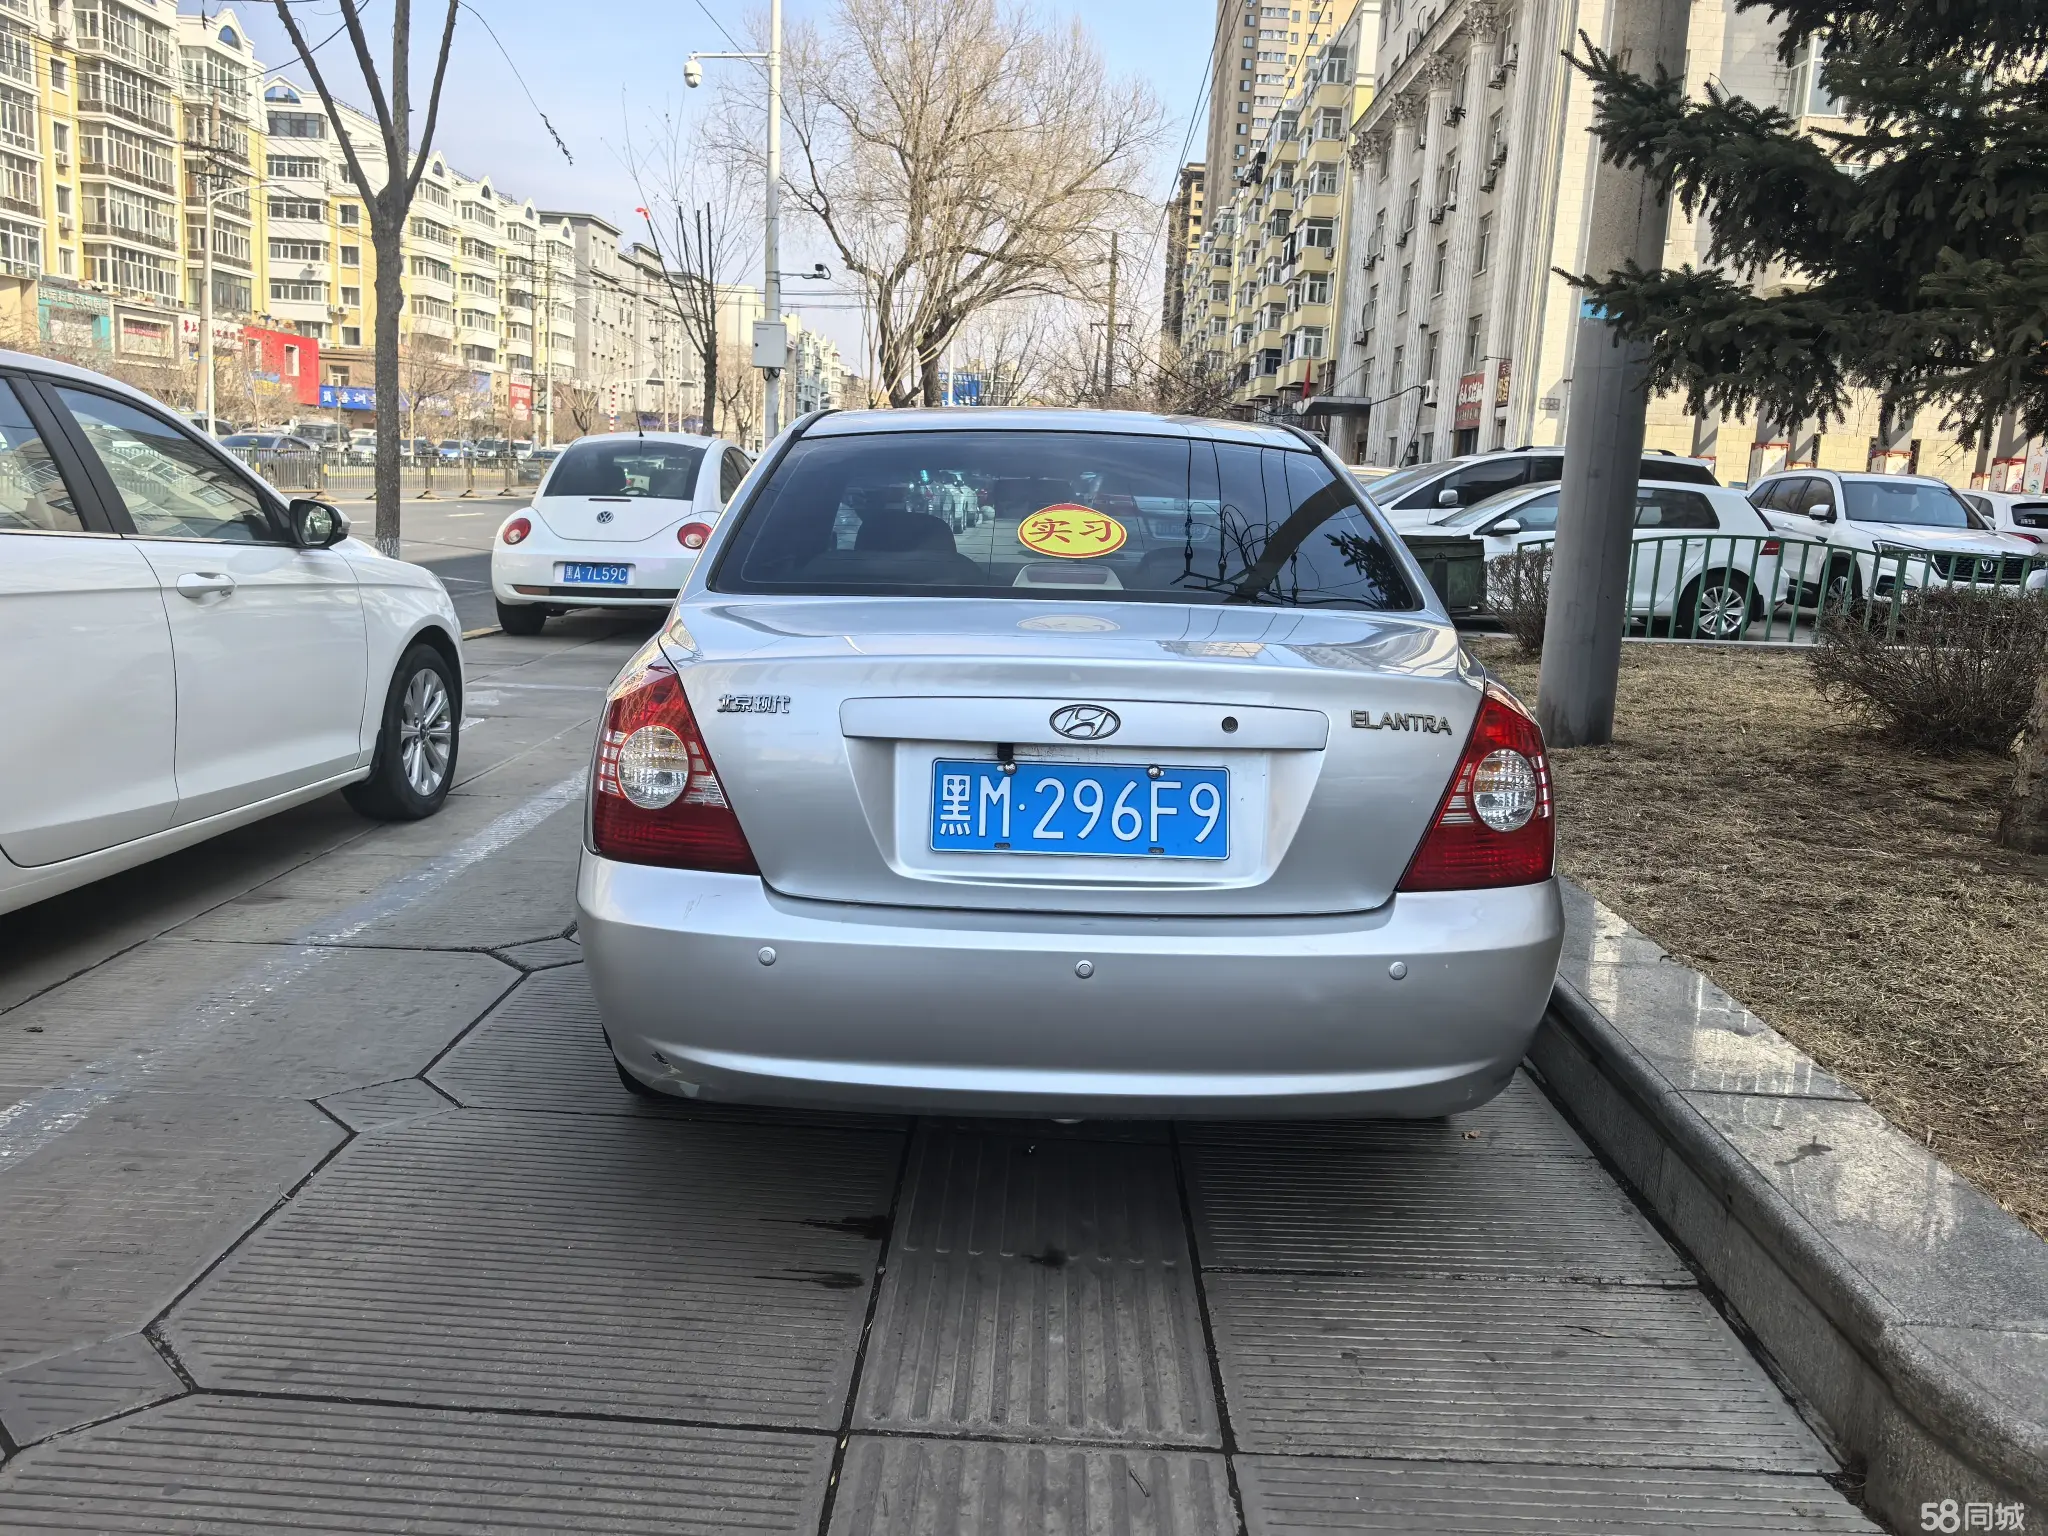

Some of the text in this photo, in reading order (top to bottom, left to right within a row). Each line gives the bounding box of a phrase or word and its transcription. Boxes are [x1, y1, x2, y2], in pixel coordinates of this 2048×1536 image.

[1028, 518, 1111, 543] 实习
[717, 694, 791, 714] 北京现代
[1351, 709, 1452, 735] ELANTRA
[939, 774, 1221, 843] 黑M·296F9
